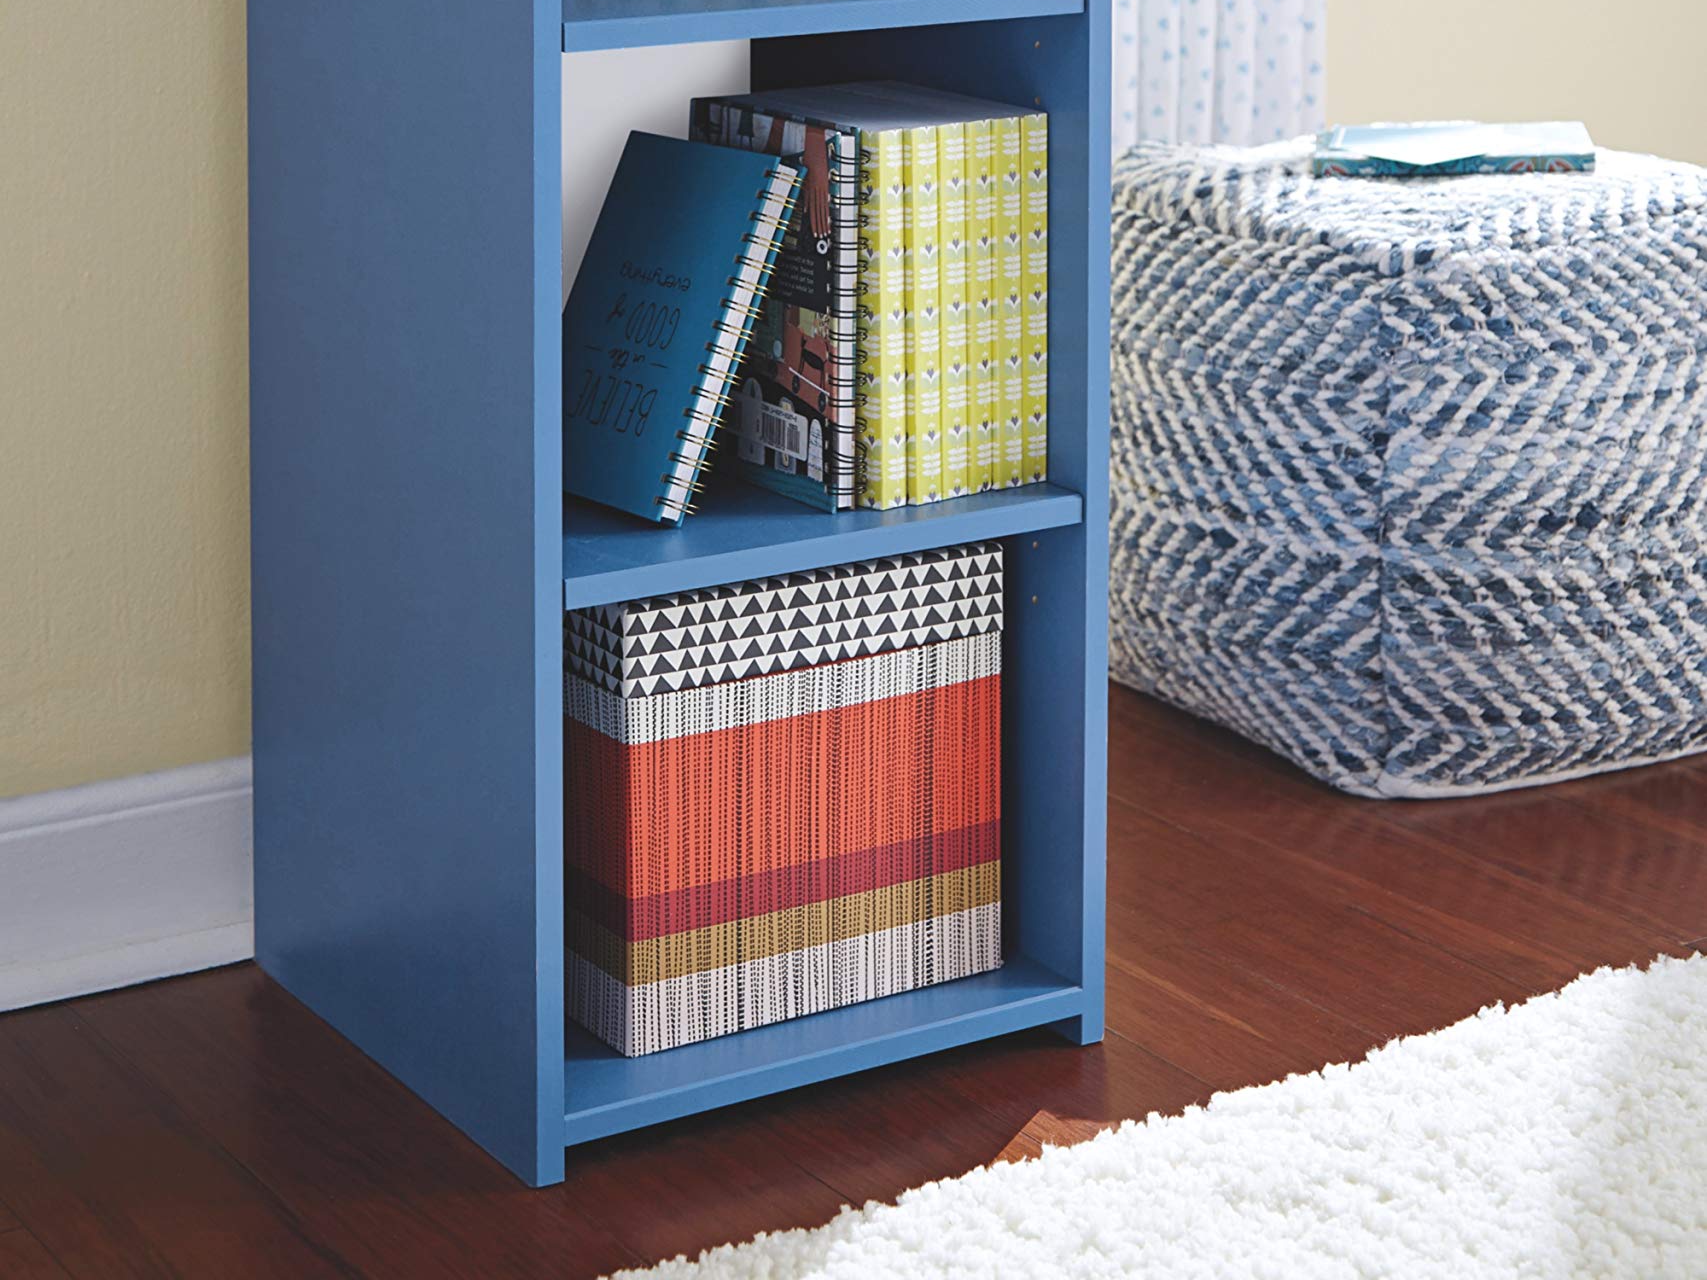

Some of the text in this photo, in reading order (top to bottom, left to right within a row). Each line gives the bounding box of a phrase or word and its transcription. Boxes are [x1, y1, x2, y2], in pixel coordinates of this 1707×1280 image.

[620, 260, 691, 291] everything
[624, 301, 681, 350] GOOD
[568, 368, 658, 437] BELIEVE
